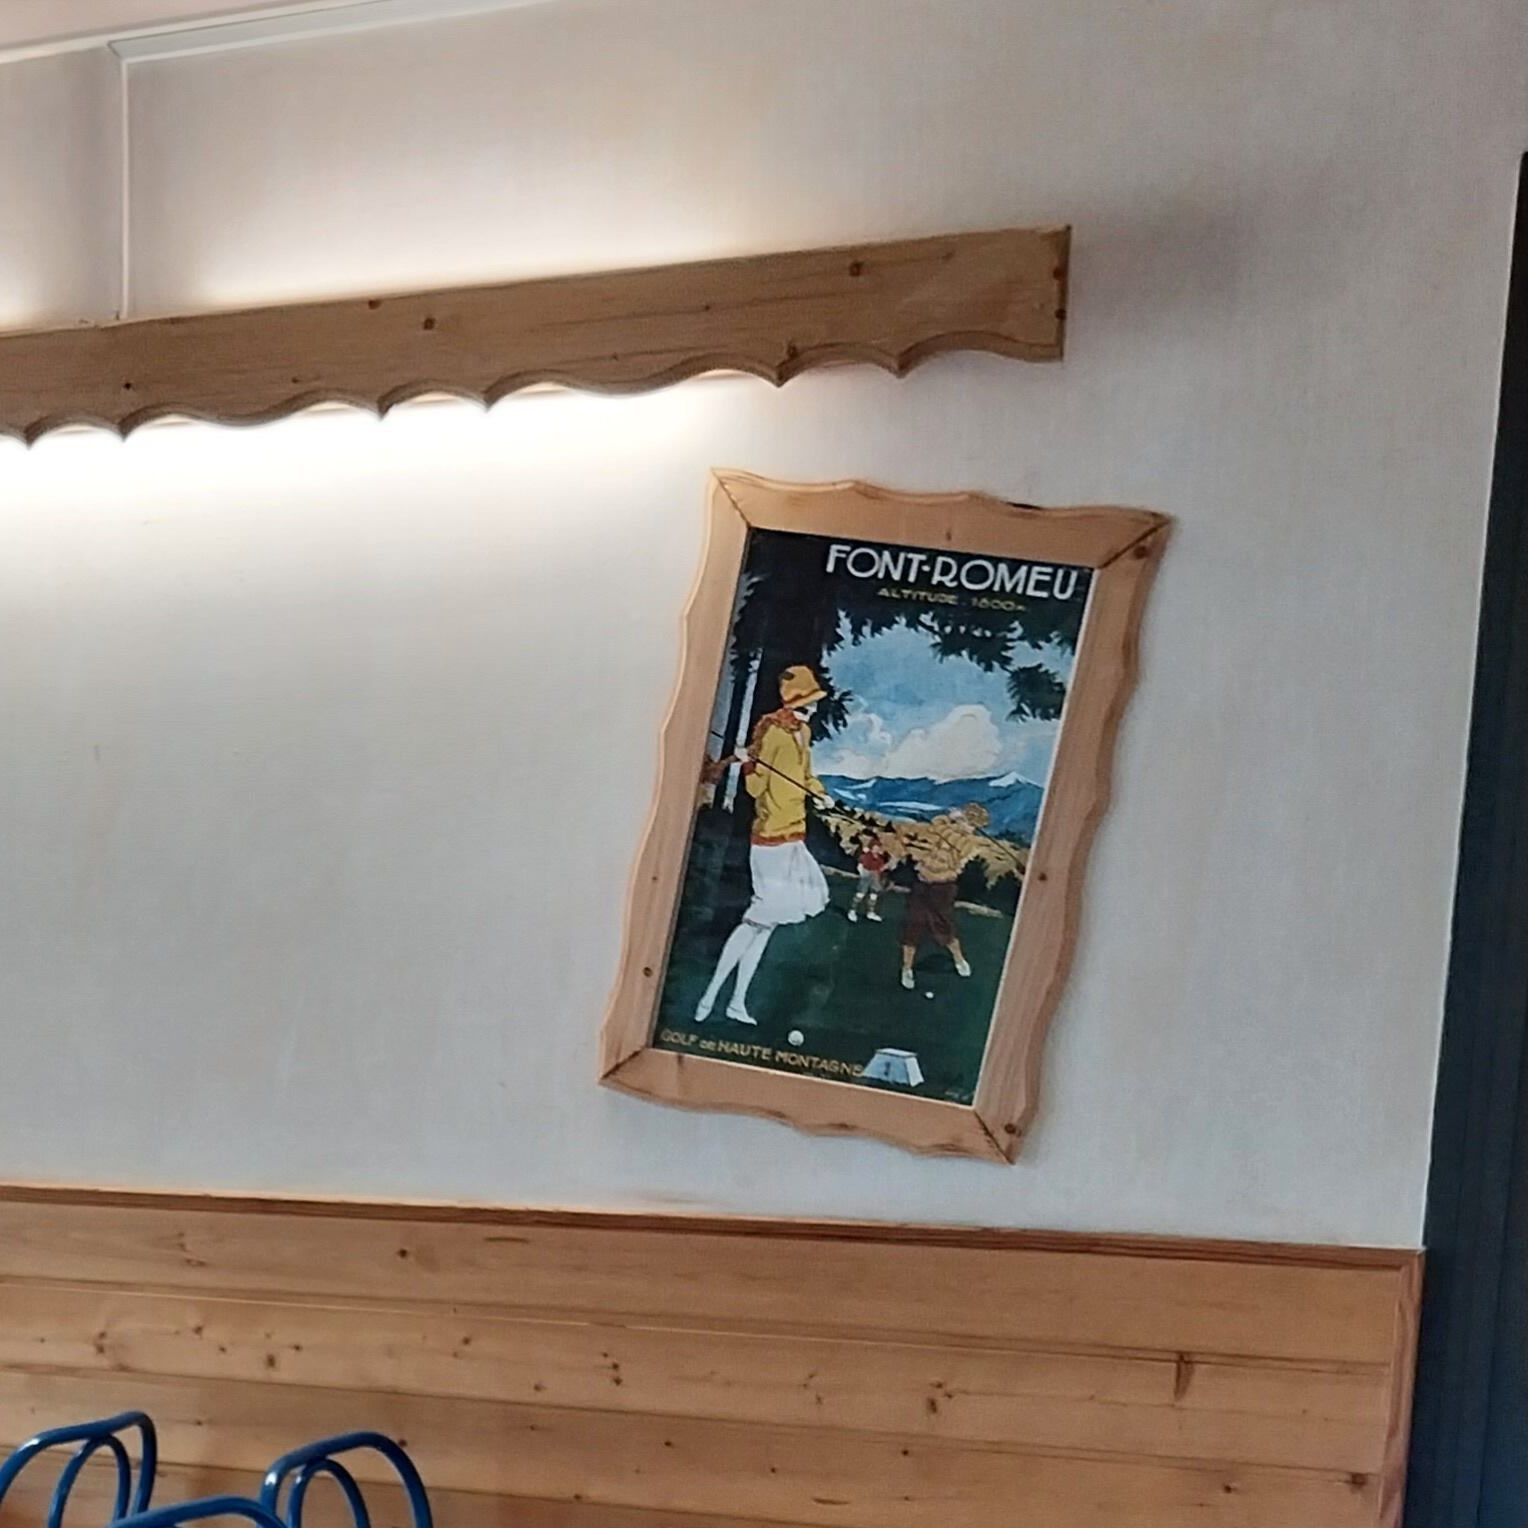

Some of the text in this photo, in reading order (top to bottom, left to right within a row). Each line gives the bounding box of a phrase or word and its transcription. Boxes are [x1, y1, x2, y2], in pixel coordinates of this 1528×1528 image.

[826, 544, 1077, 600] FONT-ROMEU
[877, 587, 959, 606] ALTITUDE
[718, 1040, 772, 1060] HAUTE
